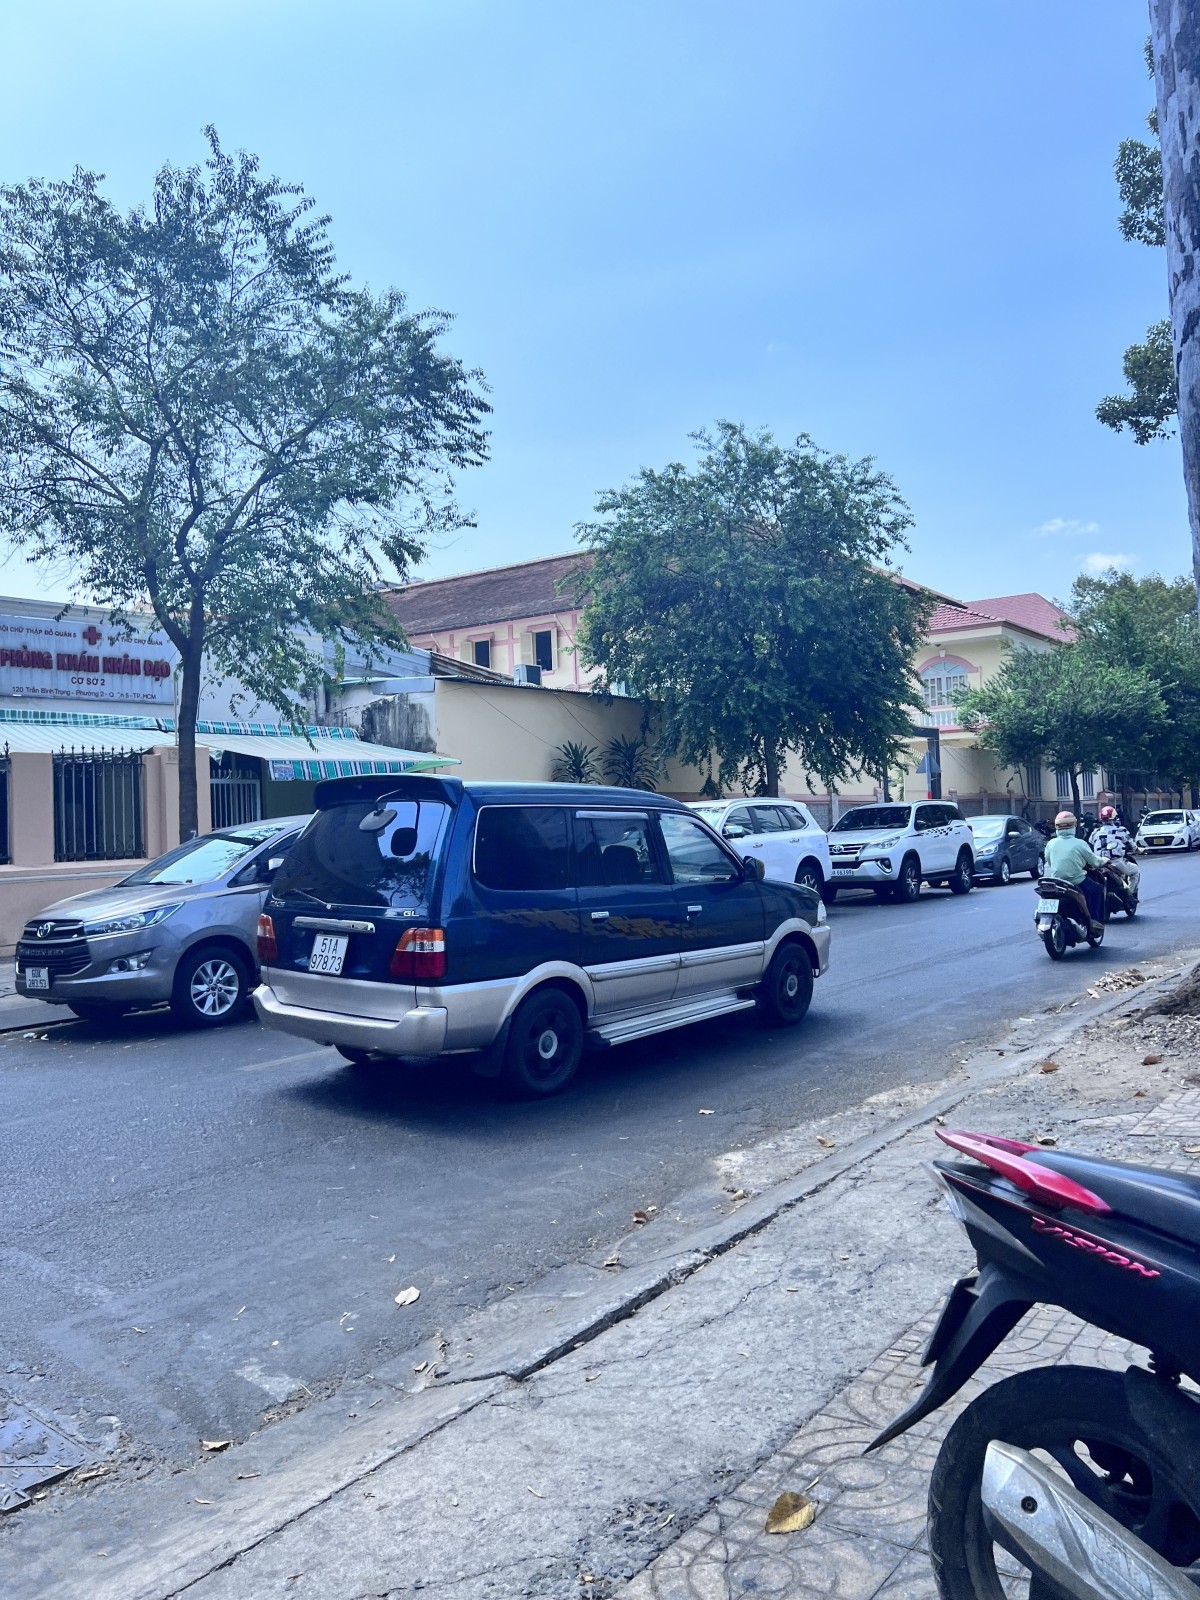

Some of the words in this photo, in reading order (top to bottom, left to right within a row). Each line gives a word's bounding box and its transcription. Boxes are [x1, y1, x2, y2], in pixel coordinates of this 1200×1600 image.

[0, 644, 53, 669] PHÒNG
[56, 650, 100, 672] KHÁM
[102, 653, 141, 676] NHÂN
[143, 659, 171, 681] ĐẠO
[71, 676, 84, 685] CƠ
[100, 678, 105, 686] 2
[321, 938, 338, 954] 51A
[310, 953, 342, 972] 978.73
